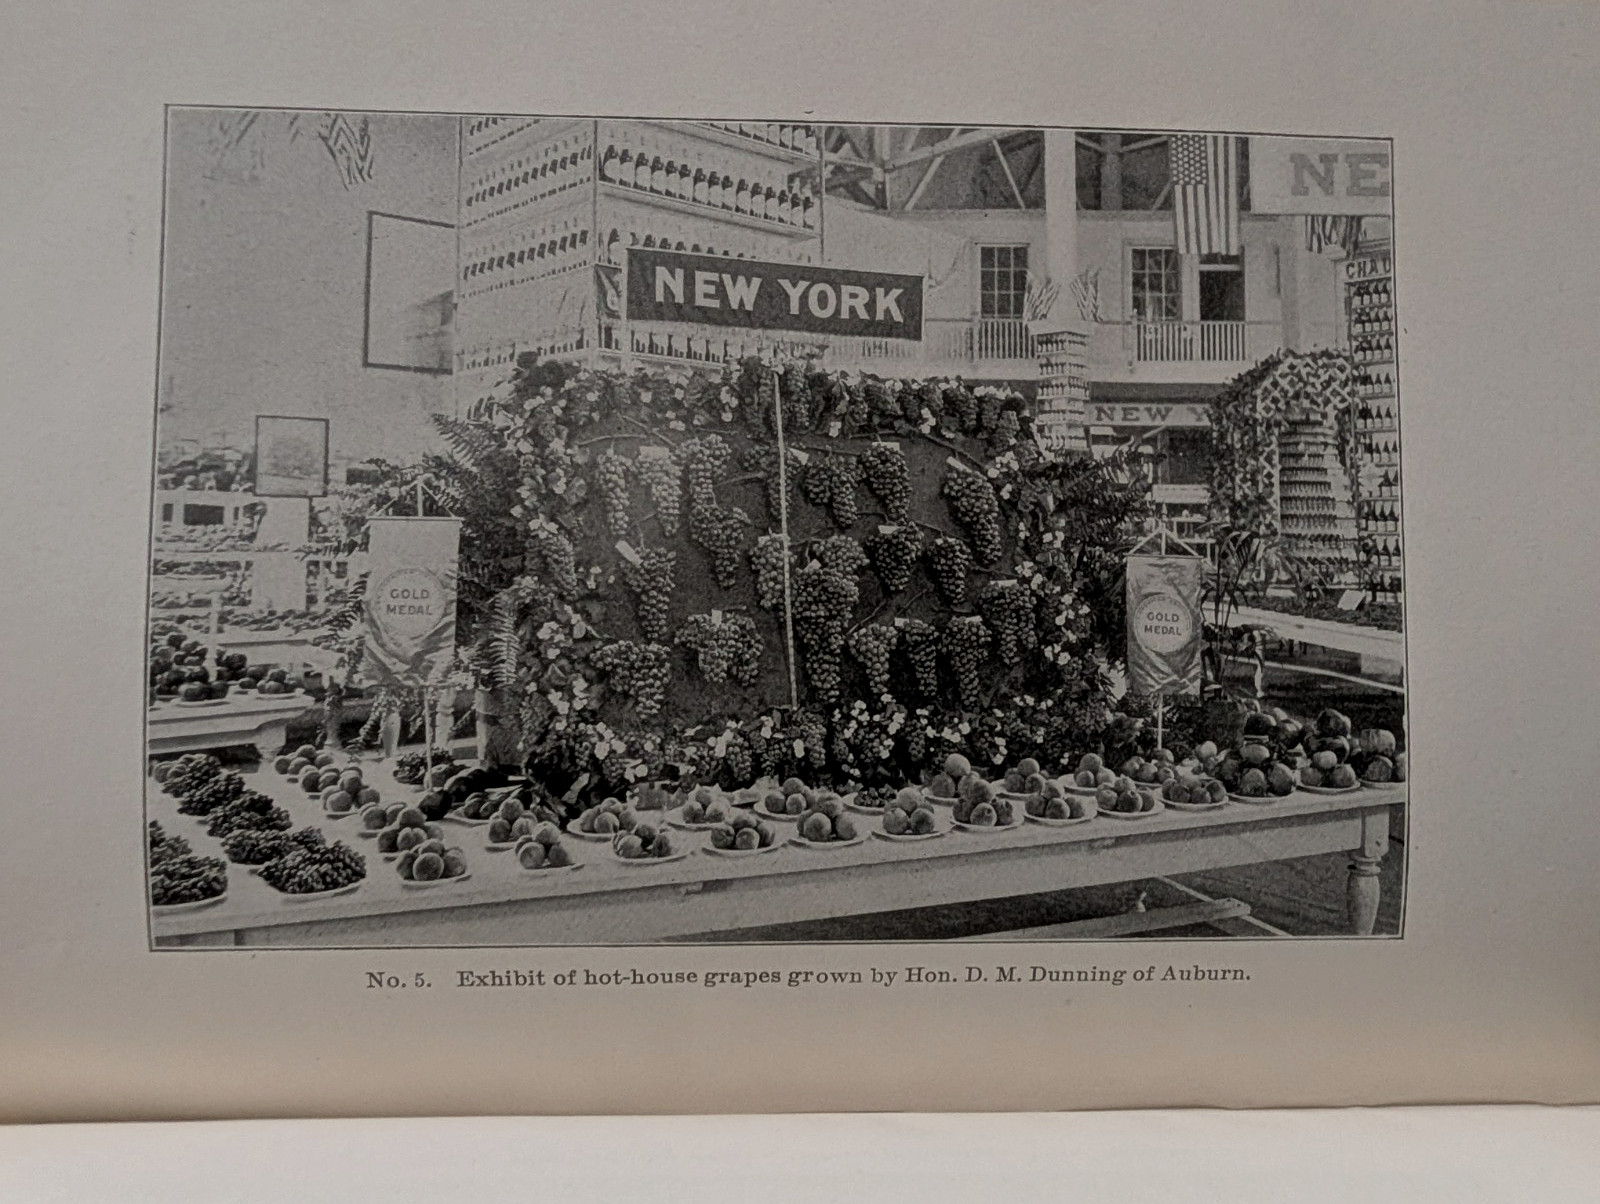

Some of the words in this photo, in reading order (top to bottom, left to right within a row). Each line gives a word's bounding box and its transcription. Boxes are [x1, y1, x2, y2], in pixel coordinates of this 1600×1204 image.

[1290, 153, 1390, 197] NE
[655, 266, 762, 311] NEW
[777, 278, 904, 323] YORK
[1095, 405, 1173, 422] NEW
[390, 588, 430, 600] GOLD
[386, 604, 432, 616] MEDAL
[1146, 611, 1180, 623] GOLD
[1144, 624, 1182, 636] MEDAL
[365, 971, 407, 989] No.
[414, 972, 432, 988] 5.
[456, 969, 546, 988] Exhibit
[553, 969, 578, 987] of
[583, 968, 698, 986] hot-house
[703, 971, 782, 989] grapes
[787, 970, 863, 988] grown
[869, 967, 898, 988] by
[904, 966, 958, 984] Hon.
[965, 966, 988, 983] D.
[995, 966, 1022, 983] M.
[1028, 965, 1127, 987] Dunning
[1132, 965, 1156, 982] of
[1160, 964, 1251, 982] Auburn.
